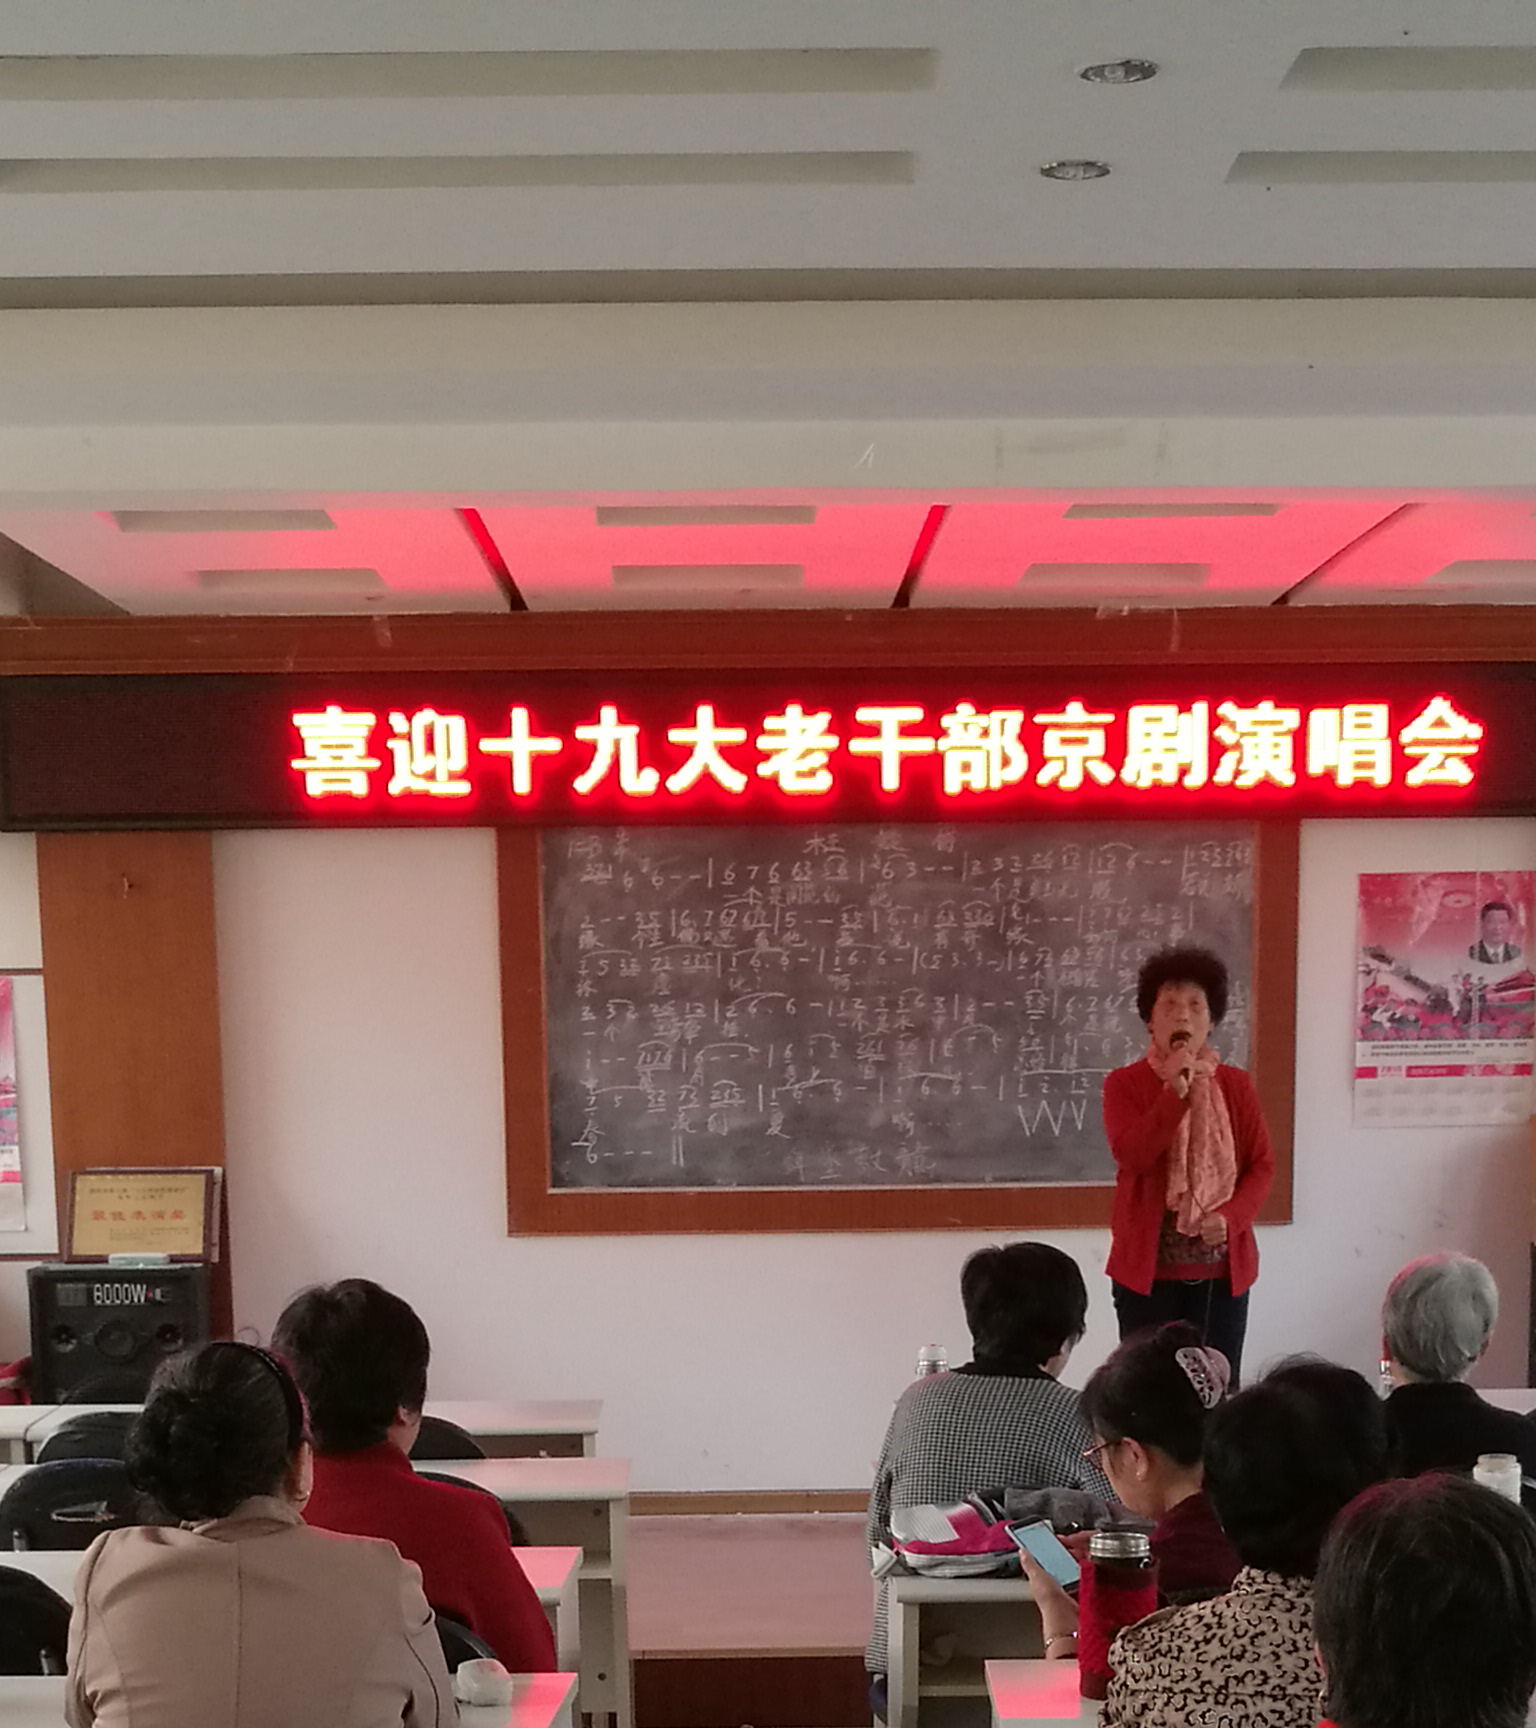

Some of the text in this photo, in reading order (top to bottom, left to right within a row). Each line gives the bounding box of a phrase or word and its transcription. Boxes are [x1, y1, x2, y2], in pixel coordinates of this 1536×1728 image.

[289, 698, 1485, 799] 喜迎十九大老干部京剧演唱会
